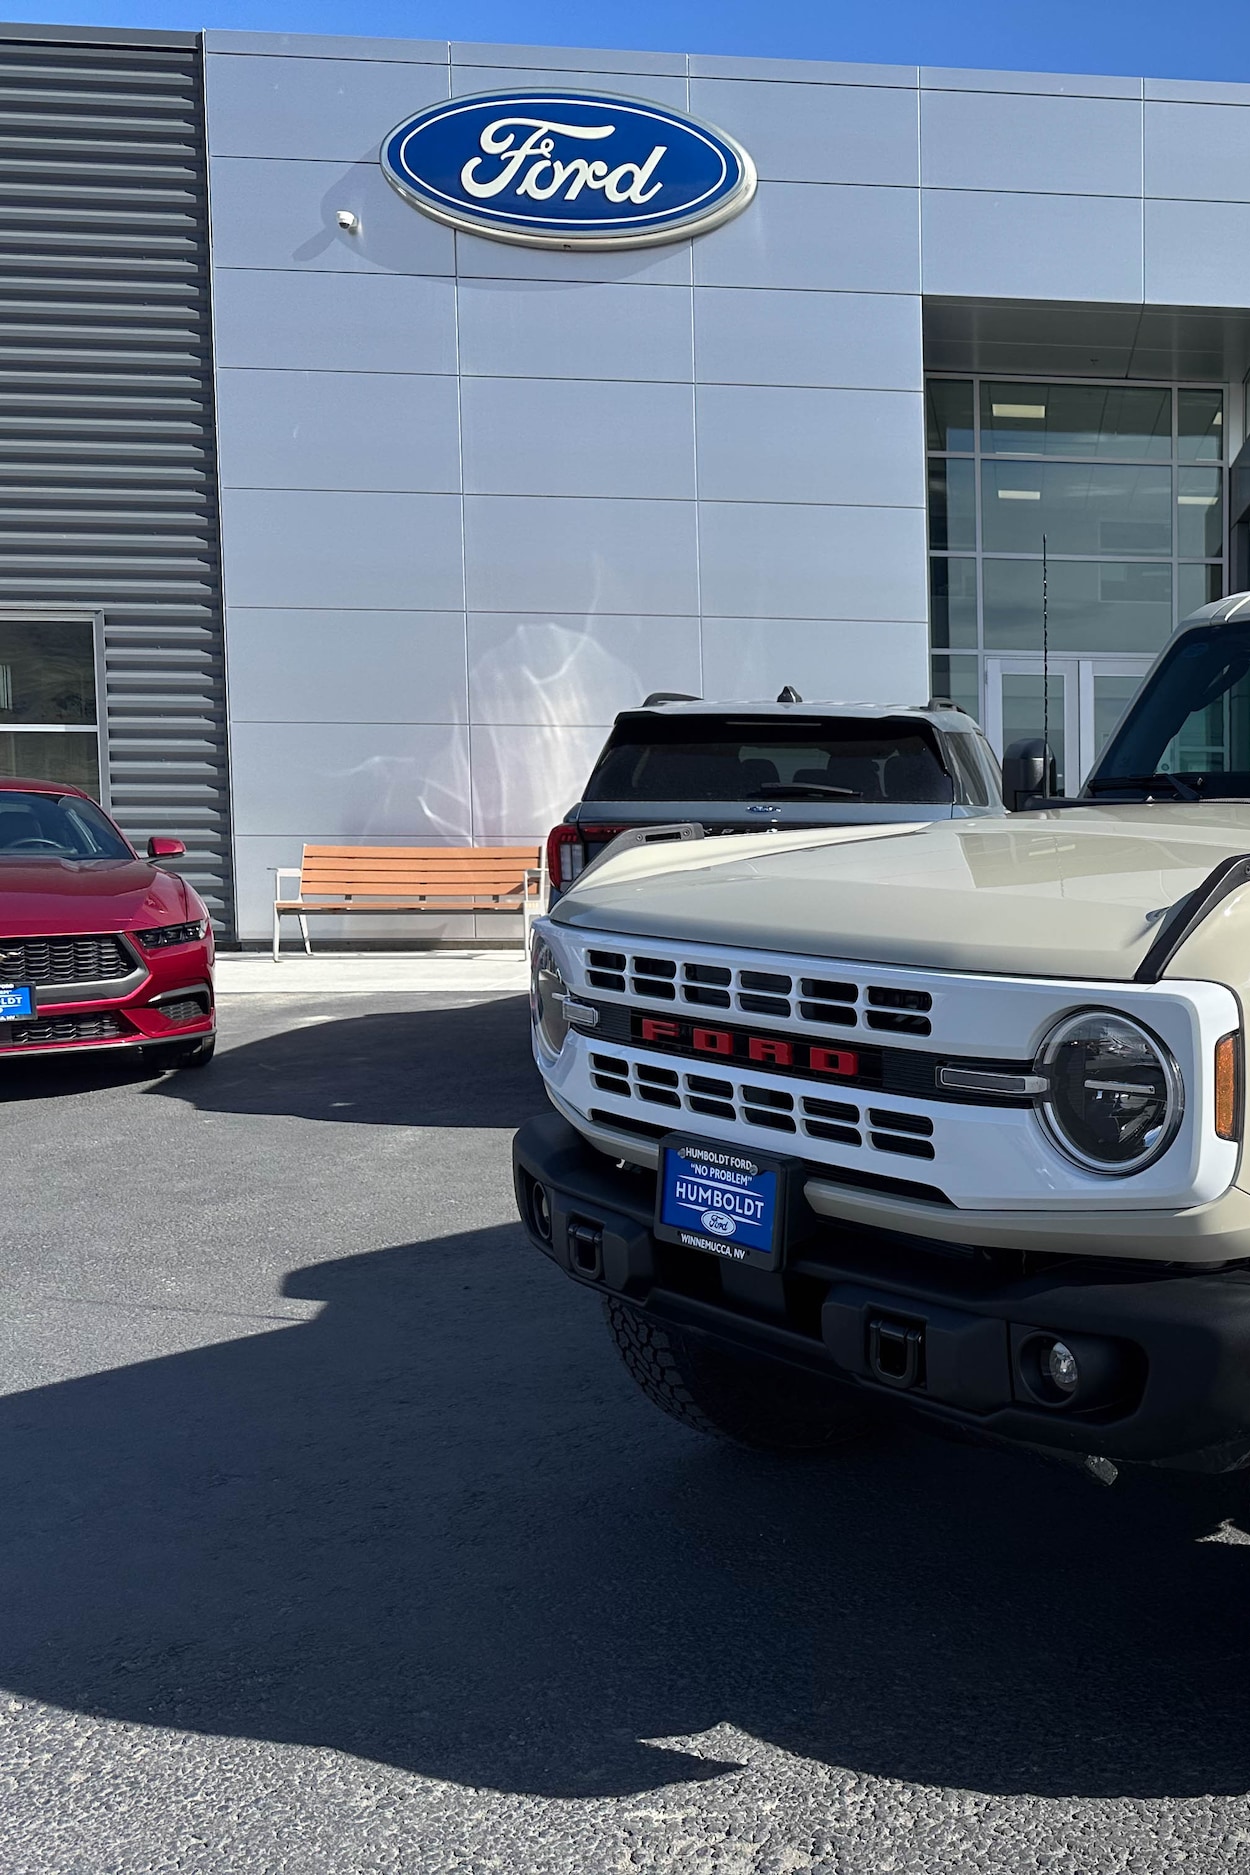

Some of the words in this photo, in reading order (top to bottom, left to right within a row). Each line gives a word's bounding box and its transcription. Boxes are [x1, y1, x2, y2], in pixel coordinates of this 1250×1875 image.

[461, 117, 667, 205] Ford
[642, 1018, 858, 1076] FORD
[685, 1147, 729, 1164] HUMBOLDT
[730, 1157, 753, 1170] FORD
[675, 1181, 764, 1219] HUMBOLDT
[708, 1214, 729, 1231] Ford
